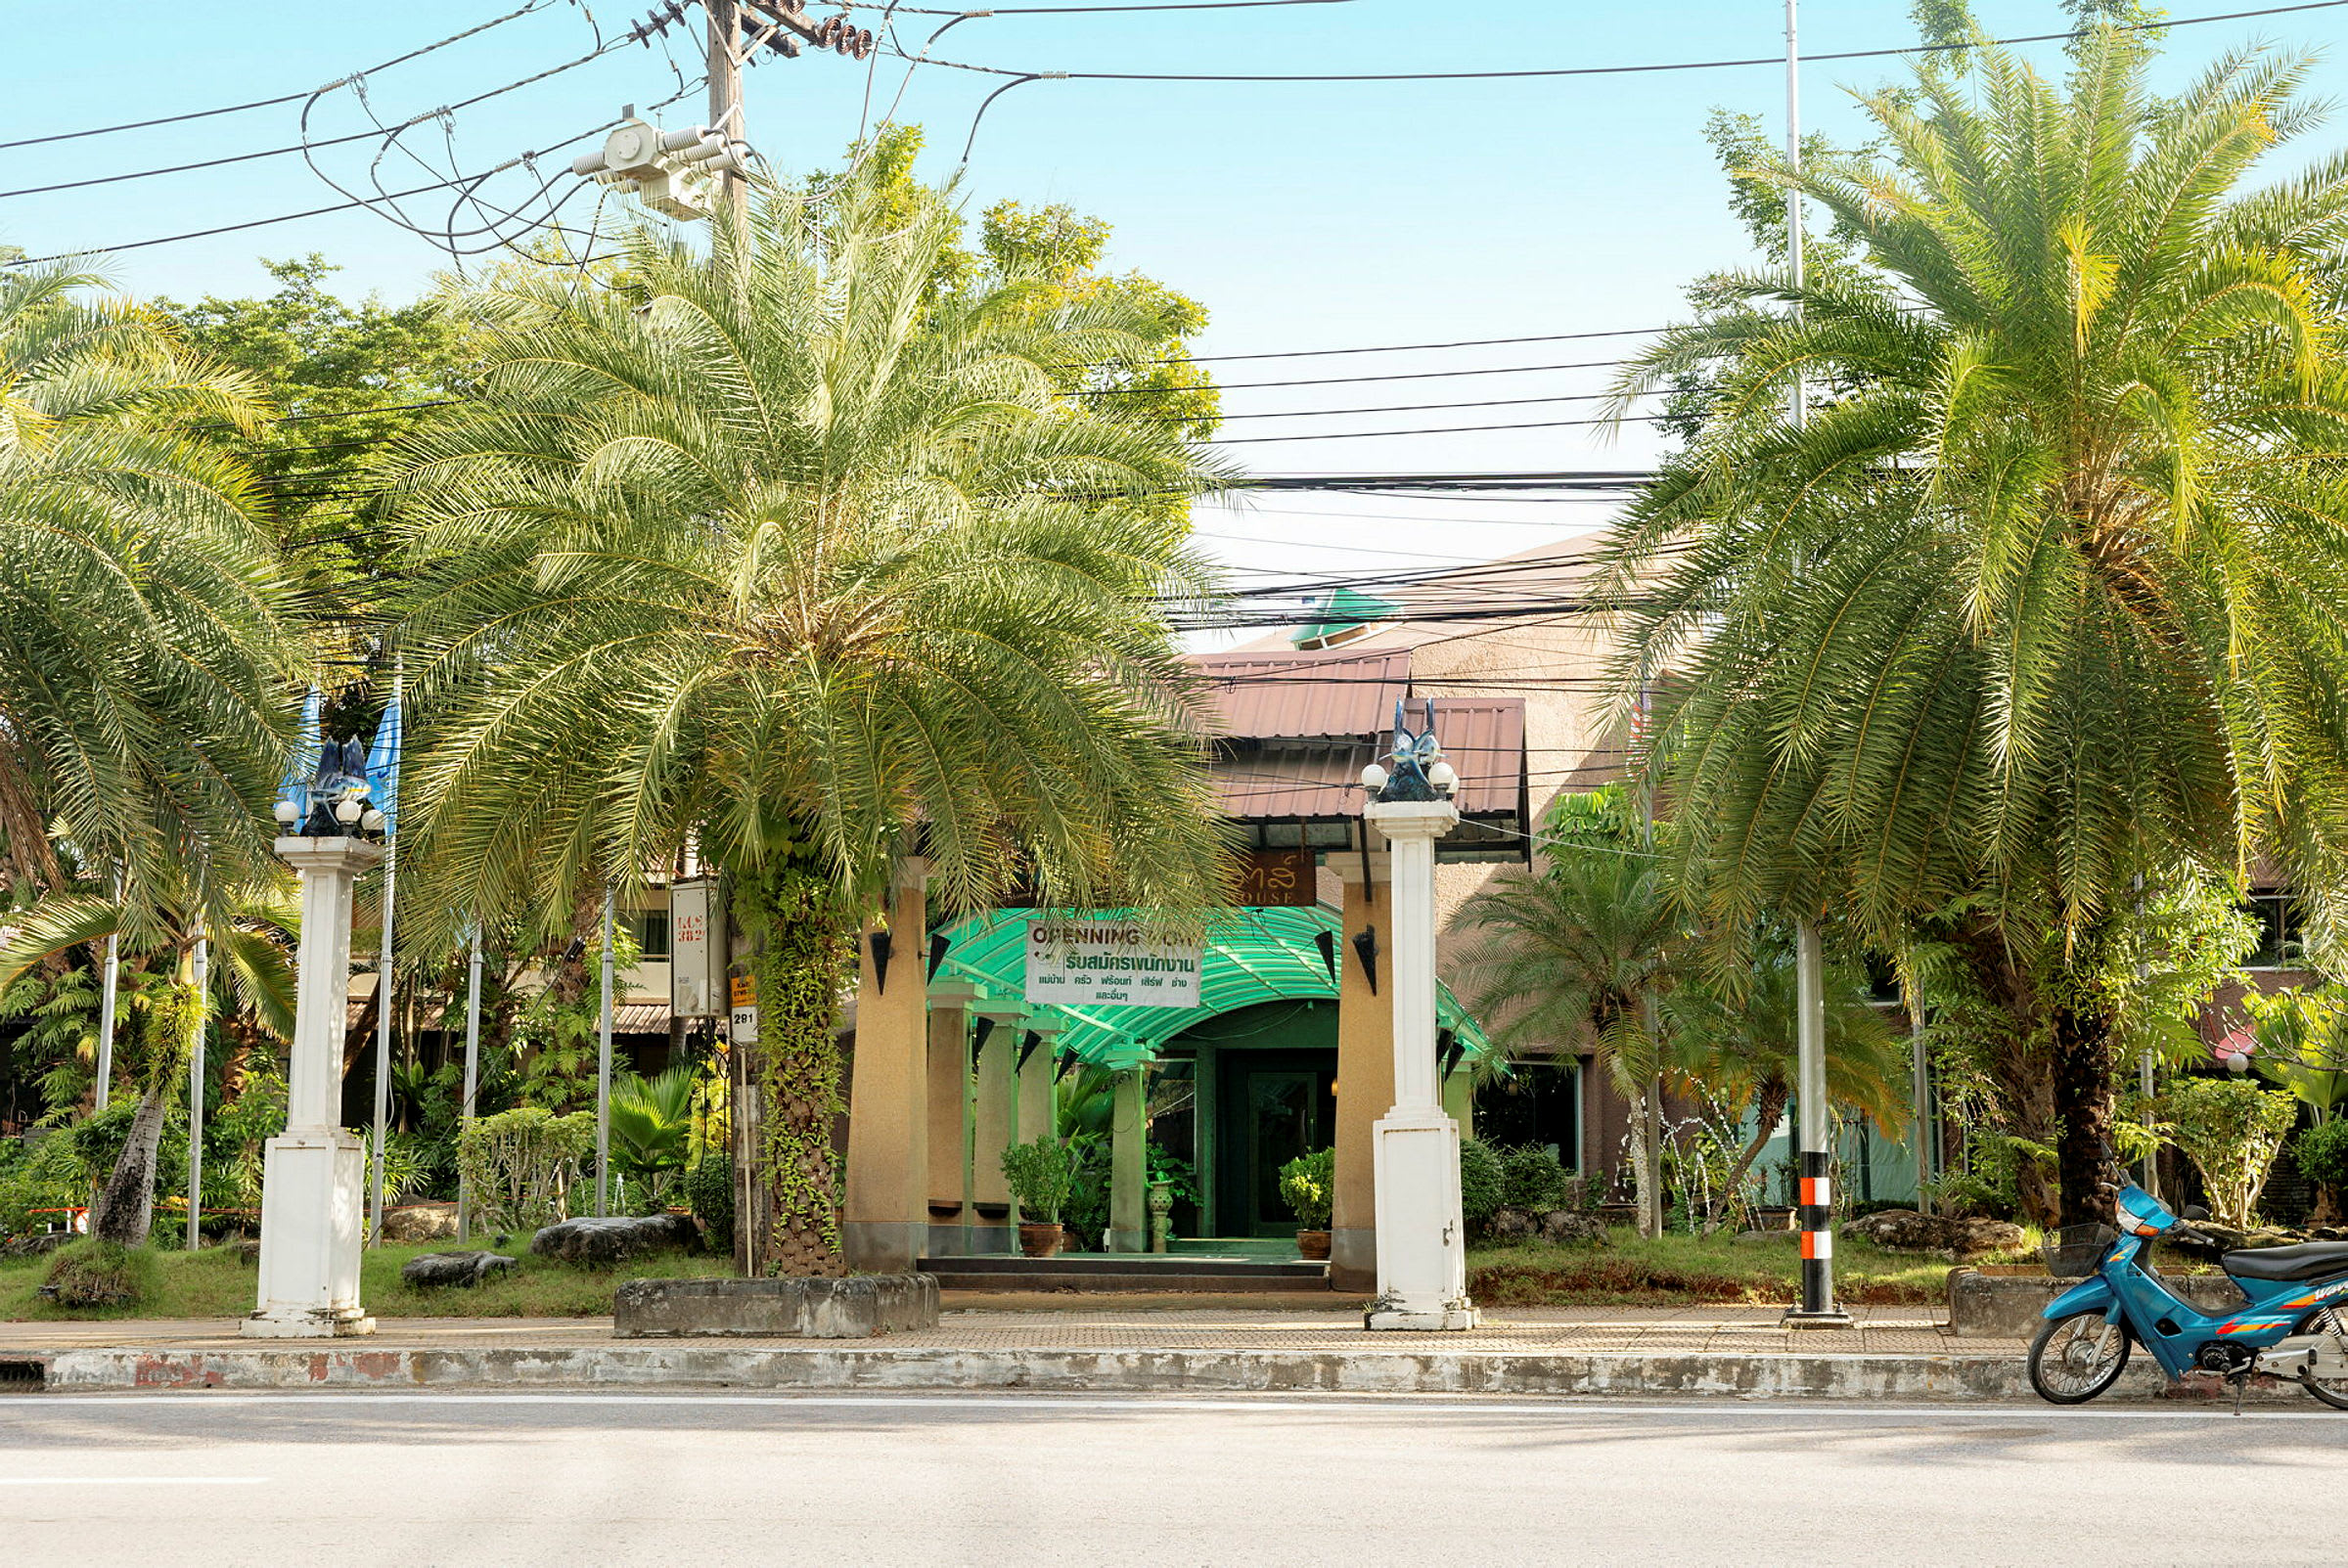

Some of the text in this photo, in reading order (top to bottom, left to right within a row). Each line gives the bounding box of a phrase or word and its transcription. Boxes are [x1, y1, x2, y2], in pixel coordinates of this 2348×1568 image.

[1065, 951, 1195, 972] รับสมัครพนักงาน
[1039, 973, 1065, 984] แม่บ้าน
[1074, 974, 1092, 985] ครัว
[1171, 976, 1188, 988] ช่าง
[1096, 988, 1128, 1002] และอื่นๆ
